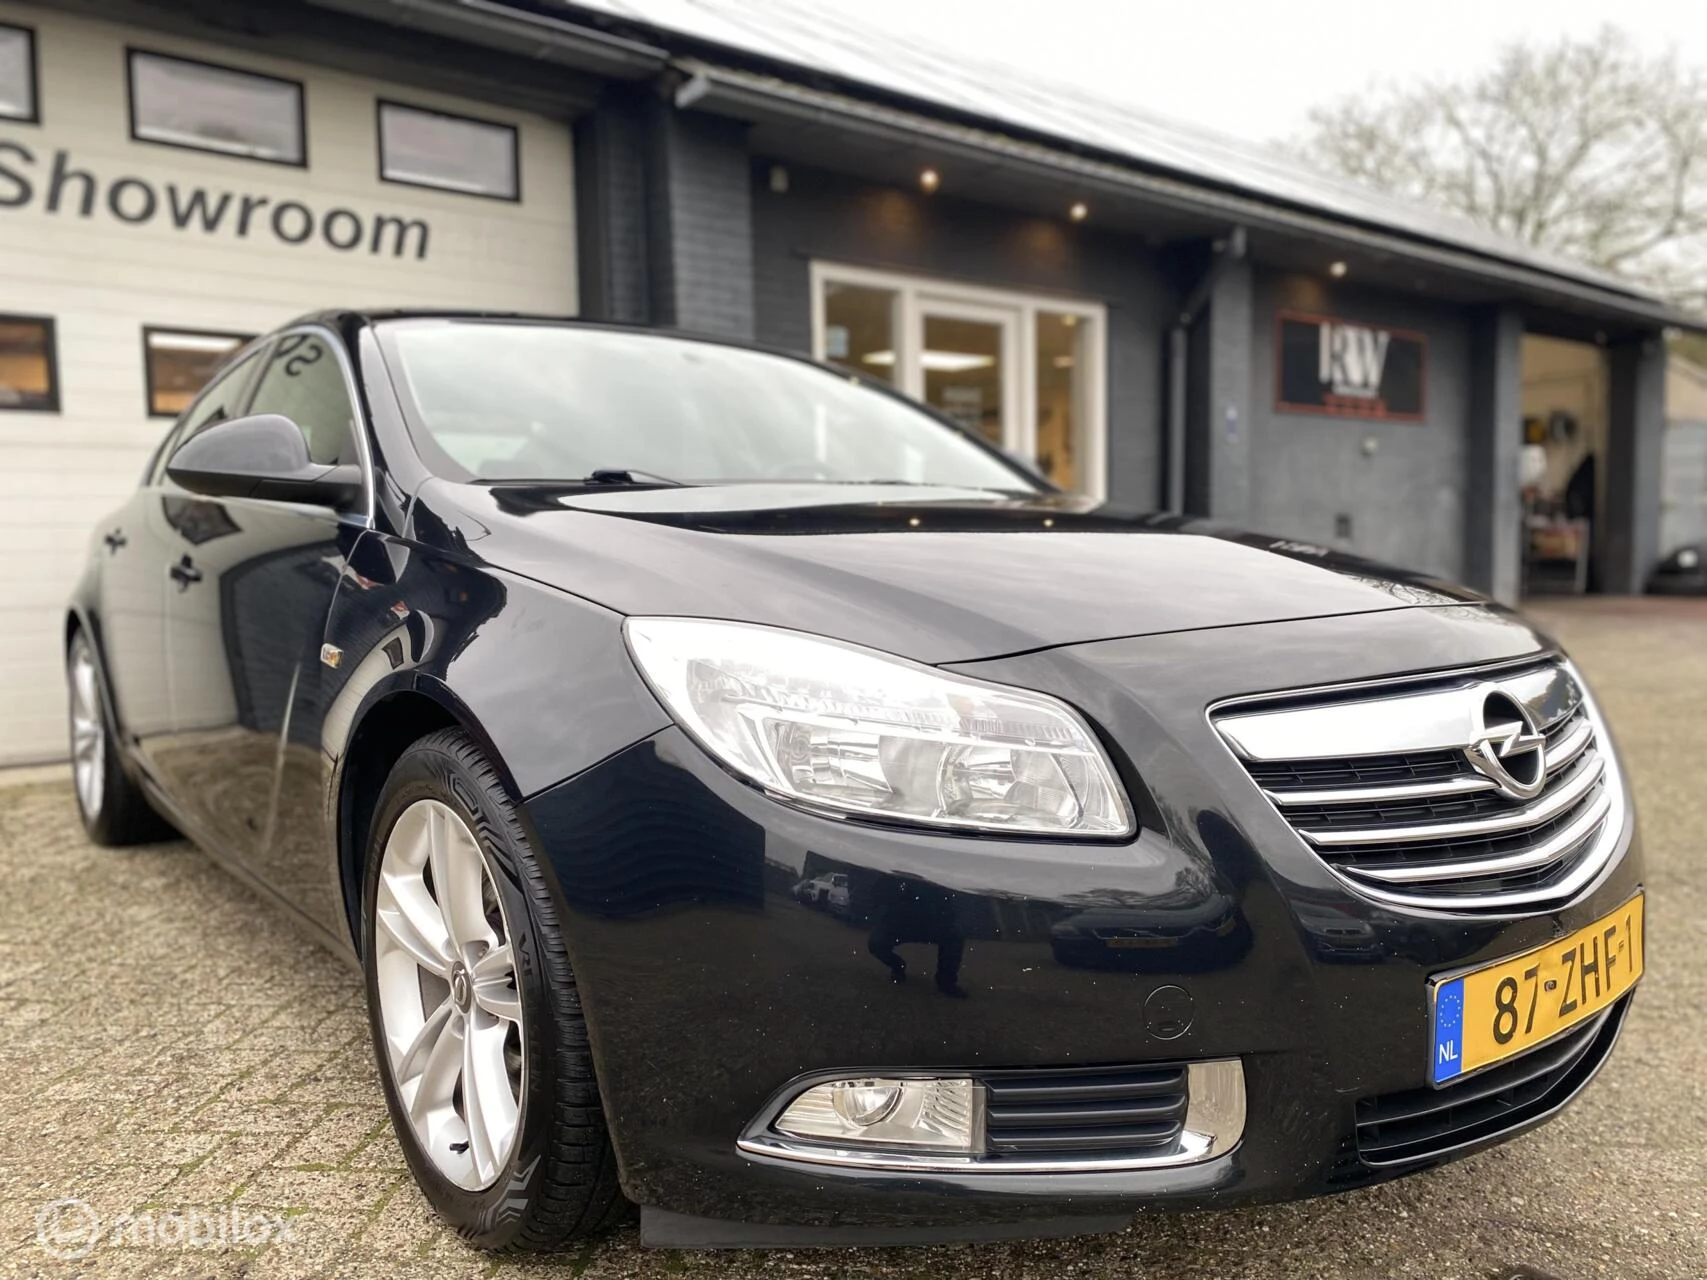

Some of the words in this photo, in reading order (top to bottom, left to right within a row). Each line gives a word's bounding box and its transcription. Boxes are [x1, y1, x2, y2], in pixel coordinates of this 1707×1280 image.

[0, 140, 430, 259] Showroom
[1492, 914, 1633, 1045] 87-ZHF-1
[1439, 1040, 1458, 1064] NL
